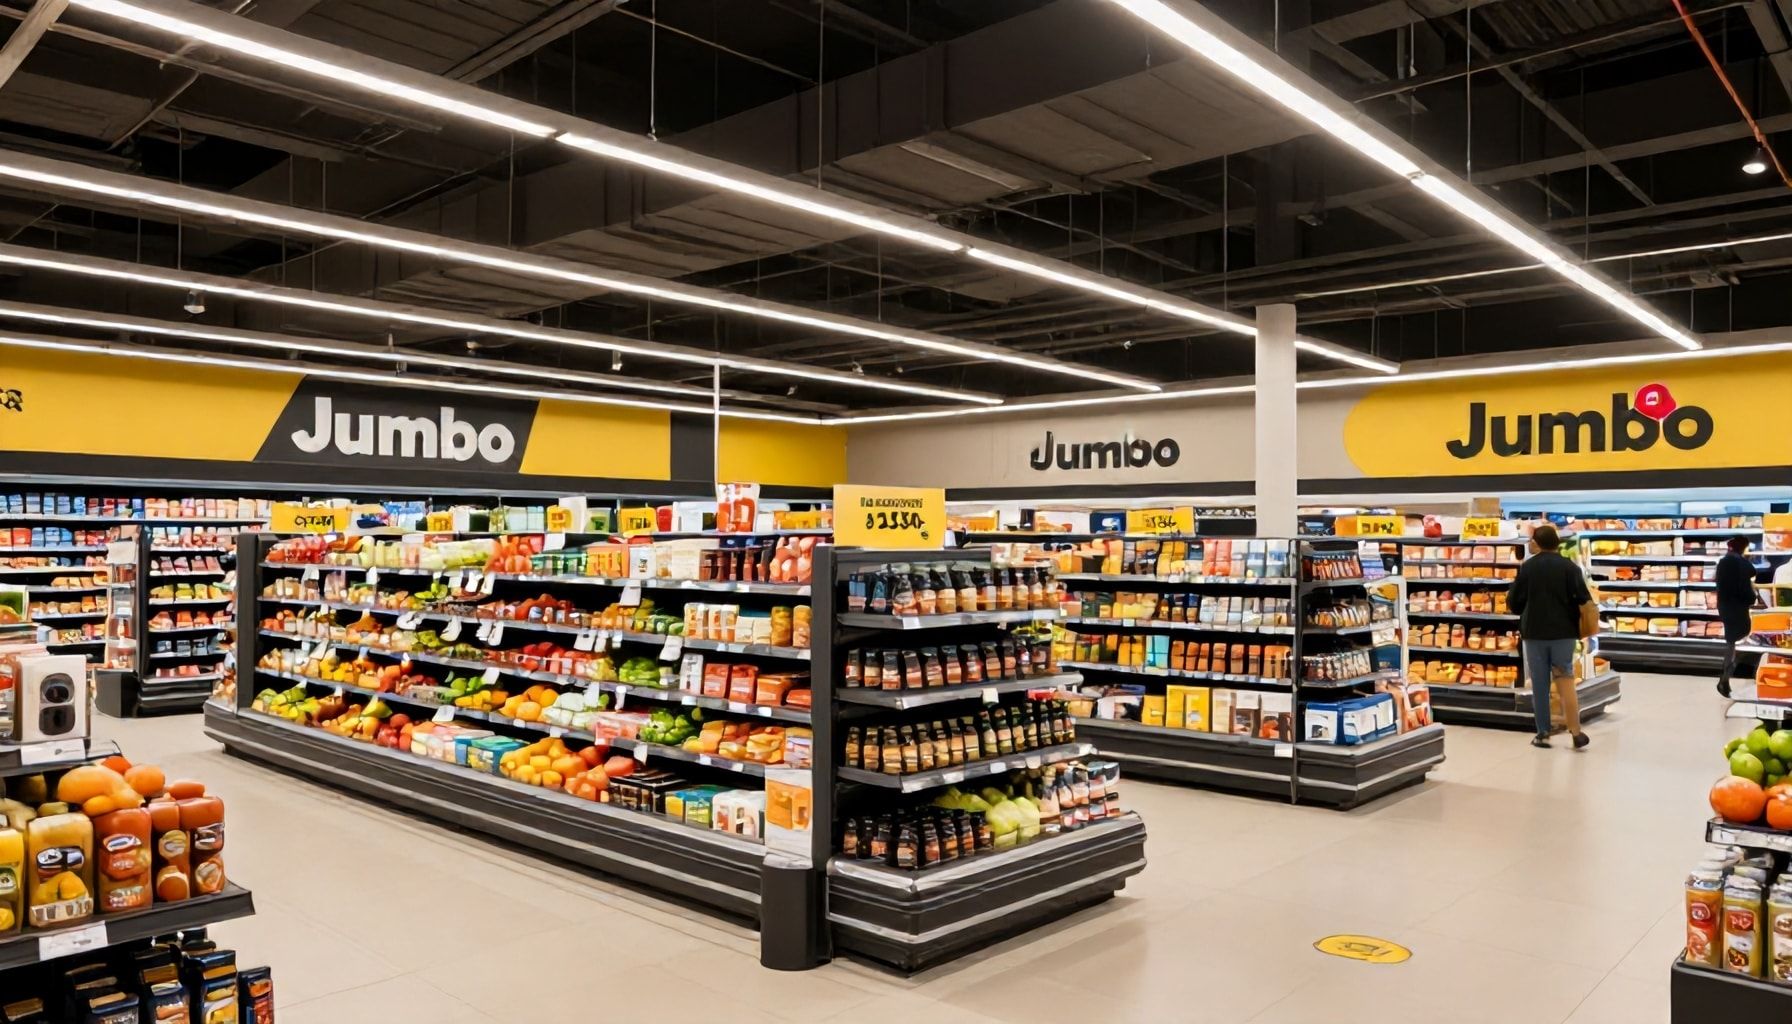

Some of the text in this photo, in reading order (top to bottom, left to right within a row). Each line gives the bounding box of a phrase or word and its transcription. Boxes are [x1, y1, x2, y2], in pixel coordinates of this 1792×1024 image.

[291, 396, 516, 463] Jumbo
[1030, 430, 1181, 471] Jumbo
[1446, 392, 1714, 459] Jumbo
